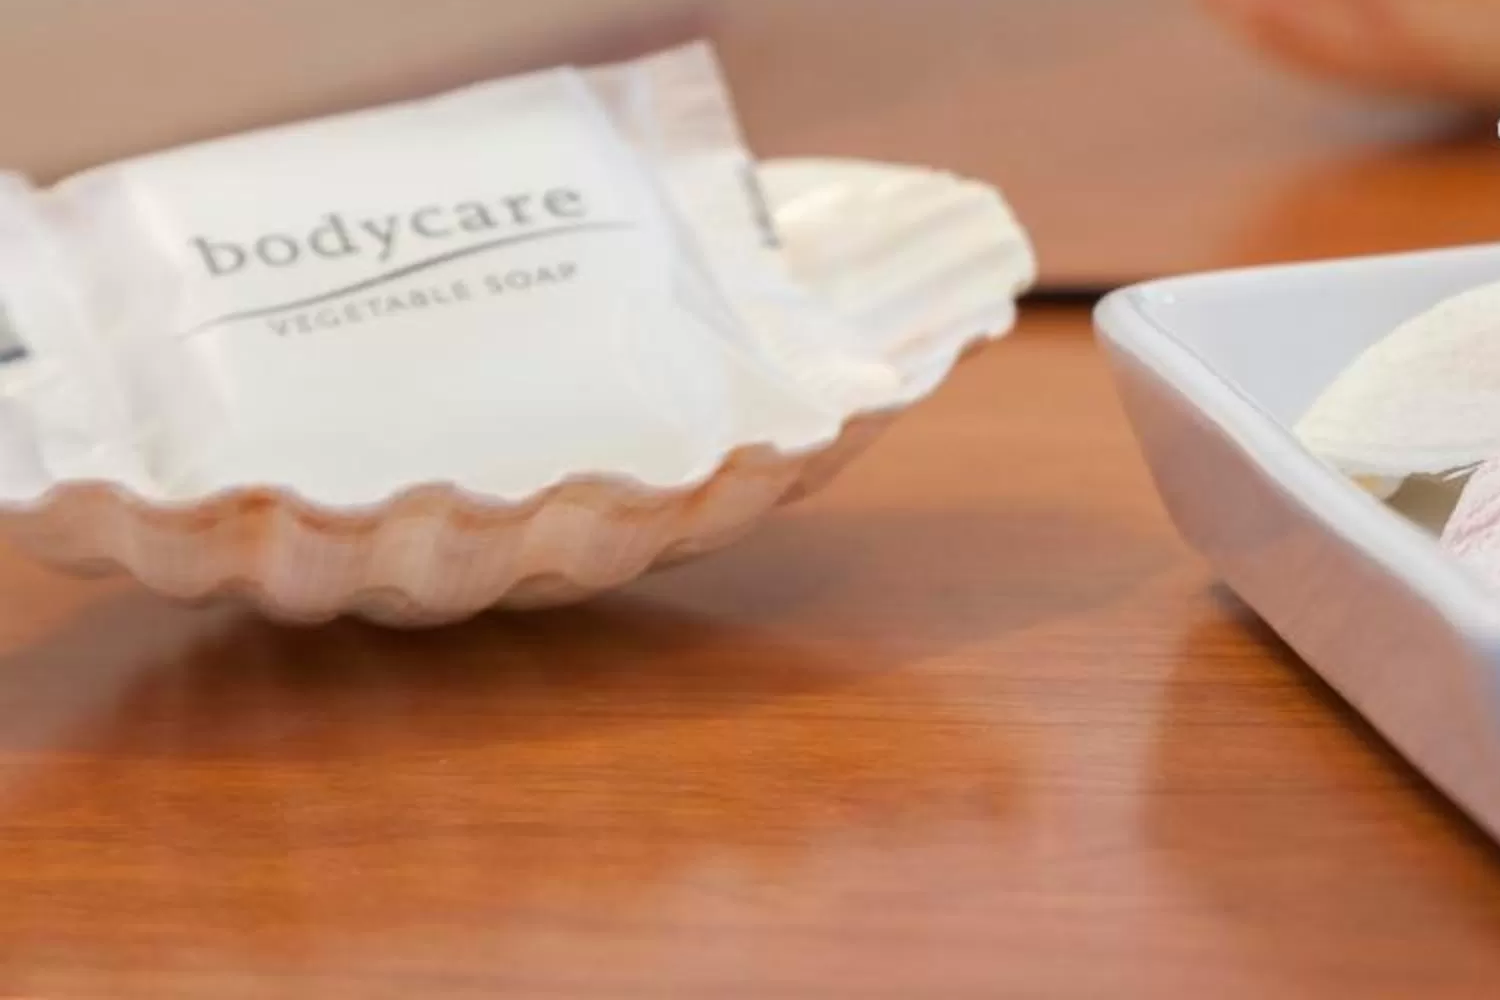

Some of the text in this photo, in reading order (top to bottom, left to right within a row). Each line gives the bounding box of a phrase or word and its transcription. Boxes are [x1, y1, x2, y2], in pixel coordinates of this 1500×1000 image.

[192, 185, 587, 277] bodycare
[268, 261, 579, 336] VEGETABLE SOAP
